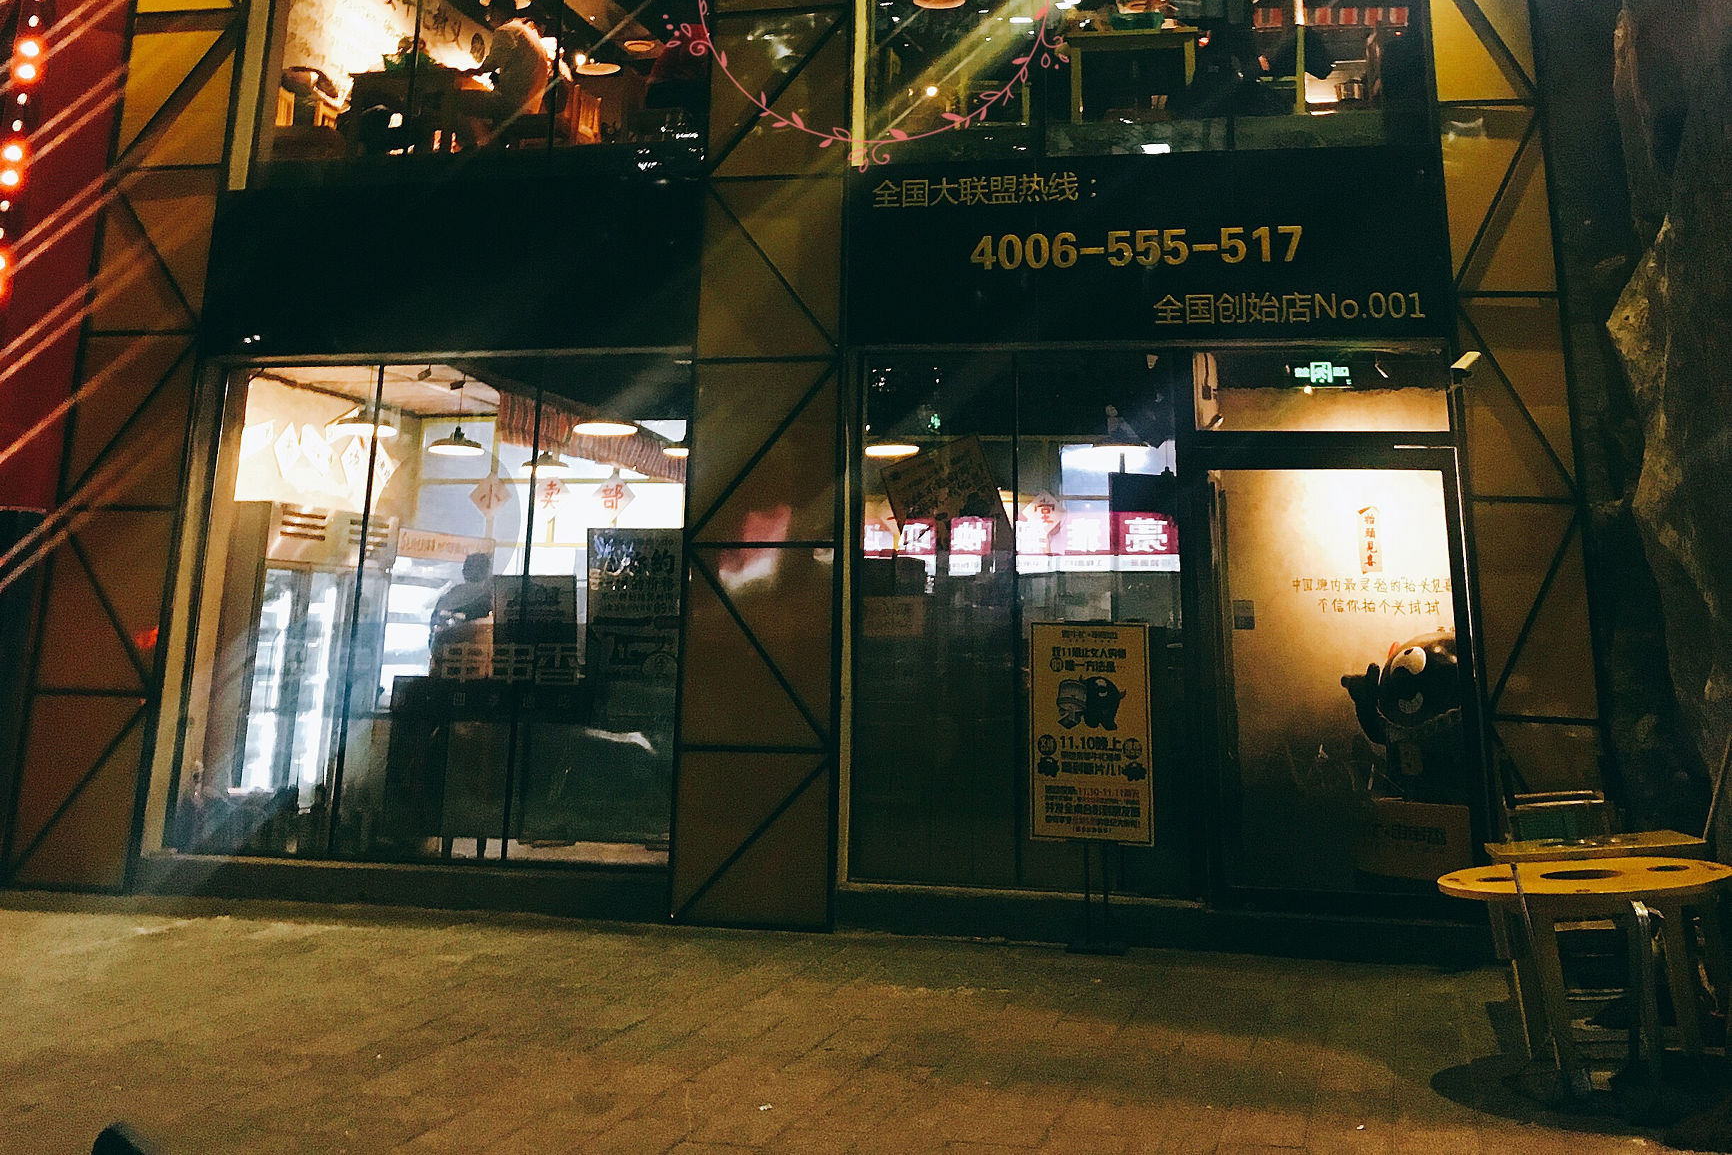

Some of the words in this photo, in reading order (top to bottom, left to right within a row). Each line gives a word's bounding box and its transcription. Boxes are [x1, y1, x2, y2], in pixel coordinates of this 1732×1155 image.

[971, 225, 1303, 271] 4006-555-517
[1153, 292, 1425, 325] 全国创始店No.001
